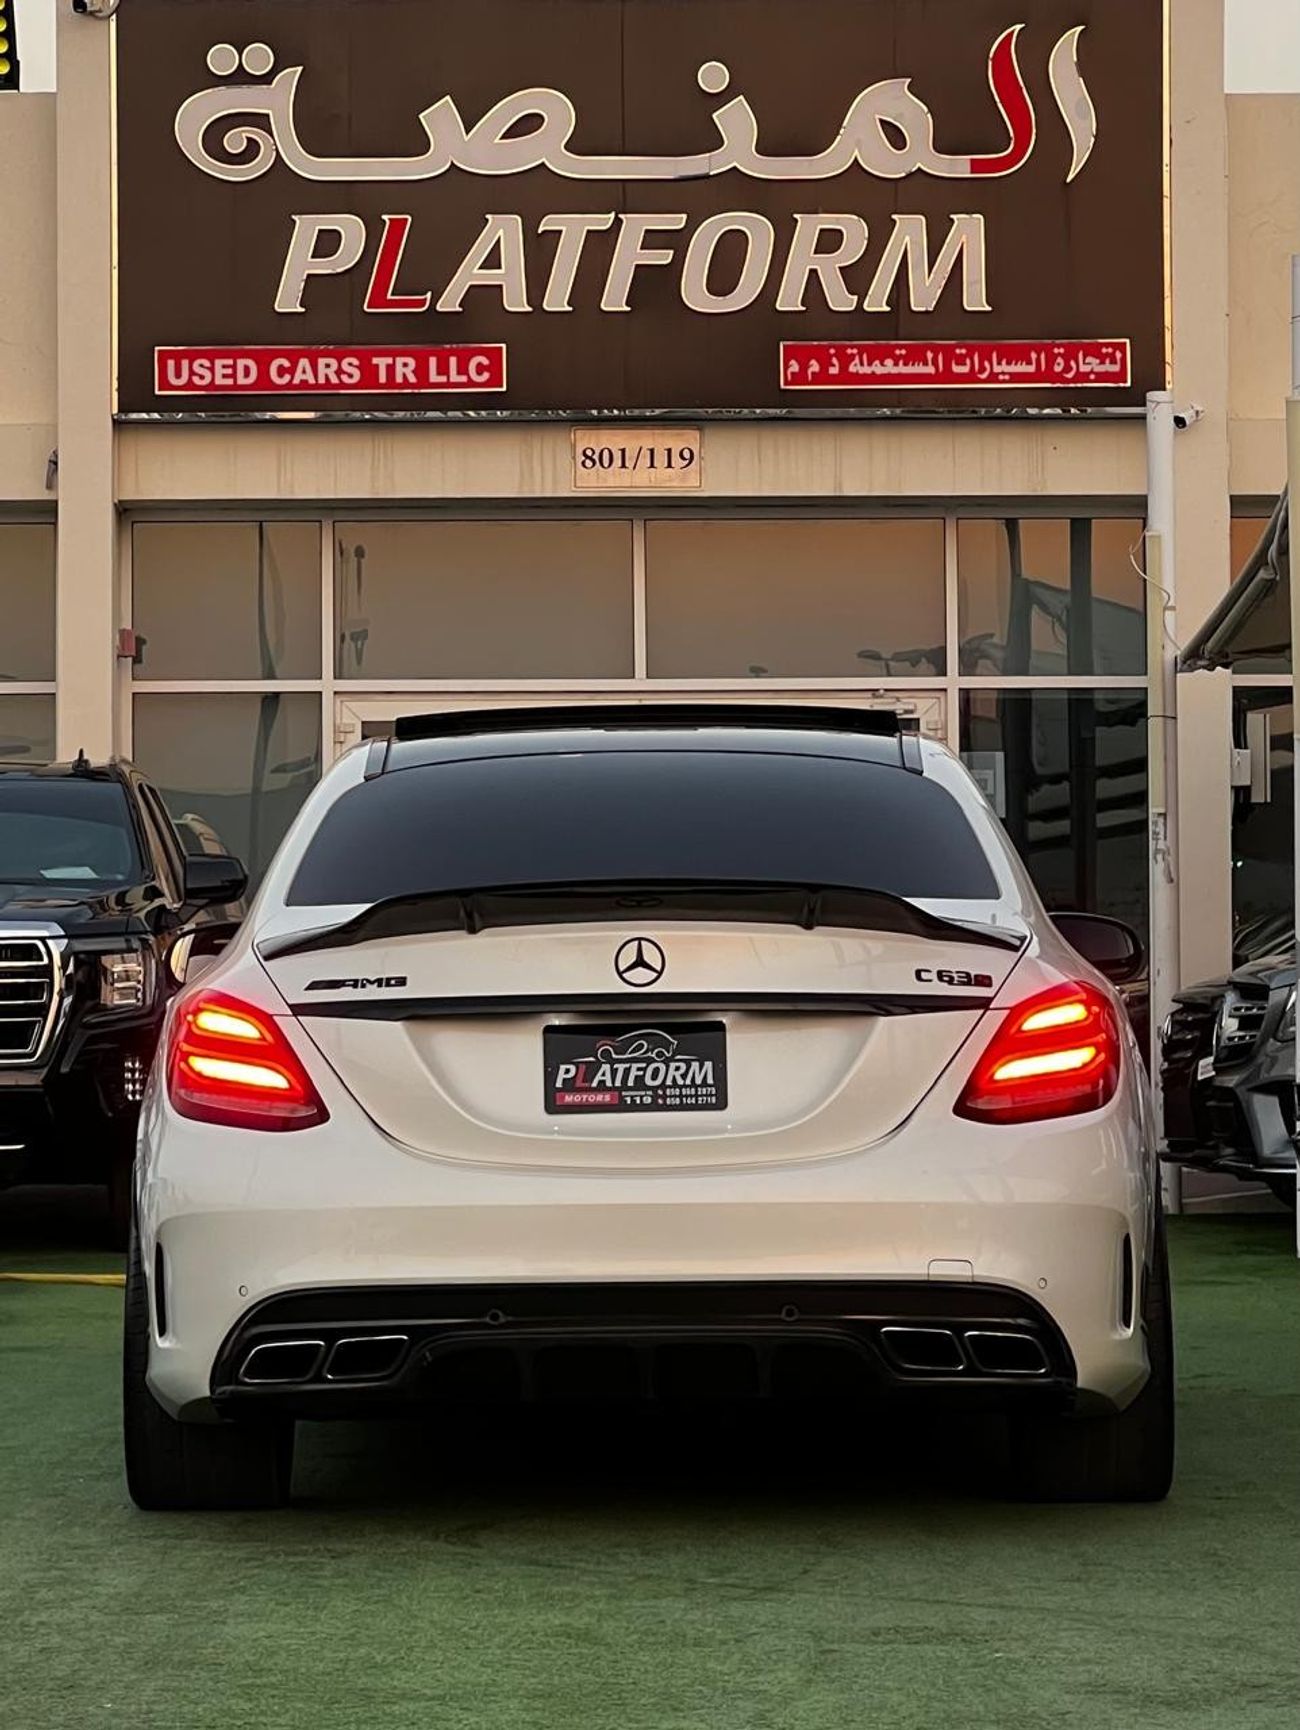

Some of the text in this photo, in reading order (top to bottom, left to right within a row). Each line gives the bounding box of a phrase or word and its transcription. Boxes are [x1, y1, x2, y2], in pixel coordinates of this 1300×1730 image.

[174, 23, 1097, 182] المنصة
[273, 211, 992, 313] PLATFORM
[166, 355, 490, 386] USED CARS TR LLC
[786, 346, 1122, 381] لتجارة السيارات المستعملة ذ م م
[581, 446, 695, 470] 801/119
[555, 1061, 714, 1088] PLATFORM
[564, 1094, 611, 1103] MOTORS
